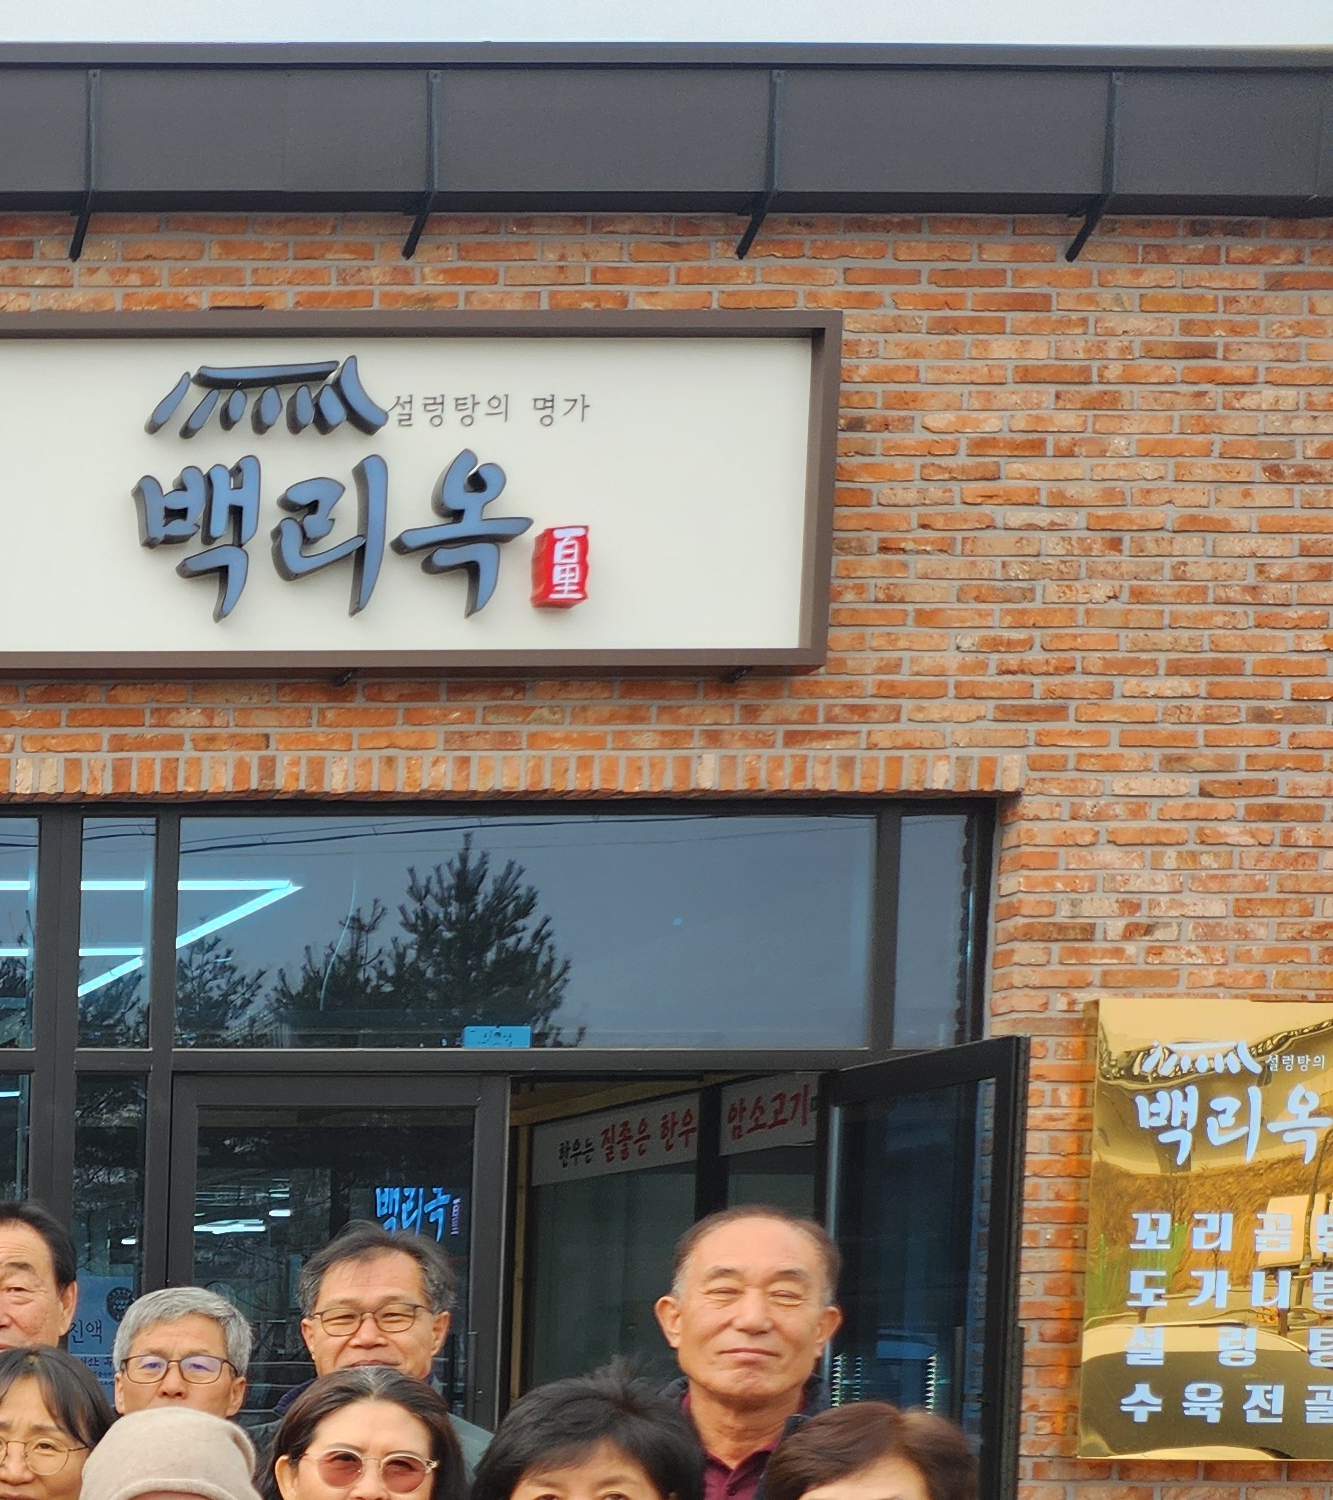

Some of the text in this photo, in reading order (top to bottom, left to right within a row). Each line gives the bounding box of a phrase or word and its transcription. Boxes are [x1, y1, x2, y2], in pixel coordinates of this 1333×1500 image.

[387, 391, 592, 430] 설렁탕의 명가
[132, 448, 534, 623] 백리옥
[1265, 1054, 1325, 1072] 설렁탕의
[660, 1108, 698, 1152] 한우
[727, 1083, 811, 1141] 암소고기
[1134, 1083, 1333, 1165] 백리옥
